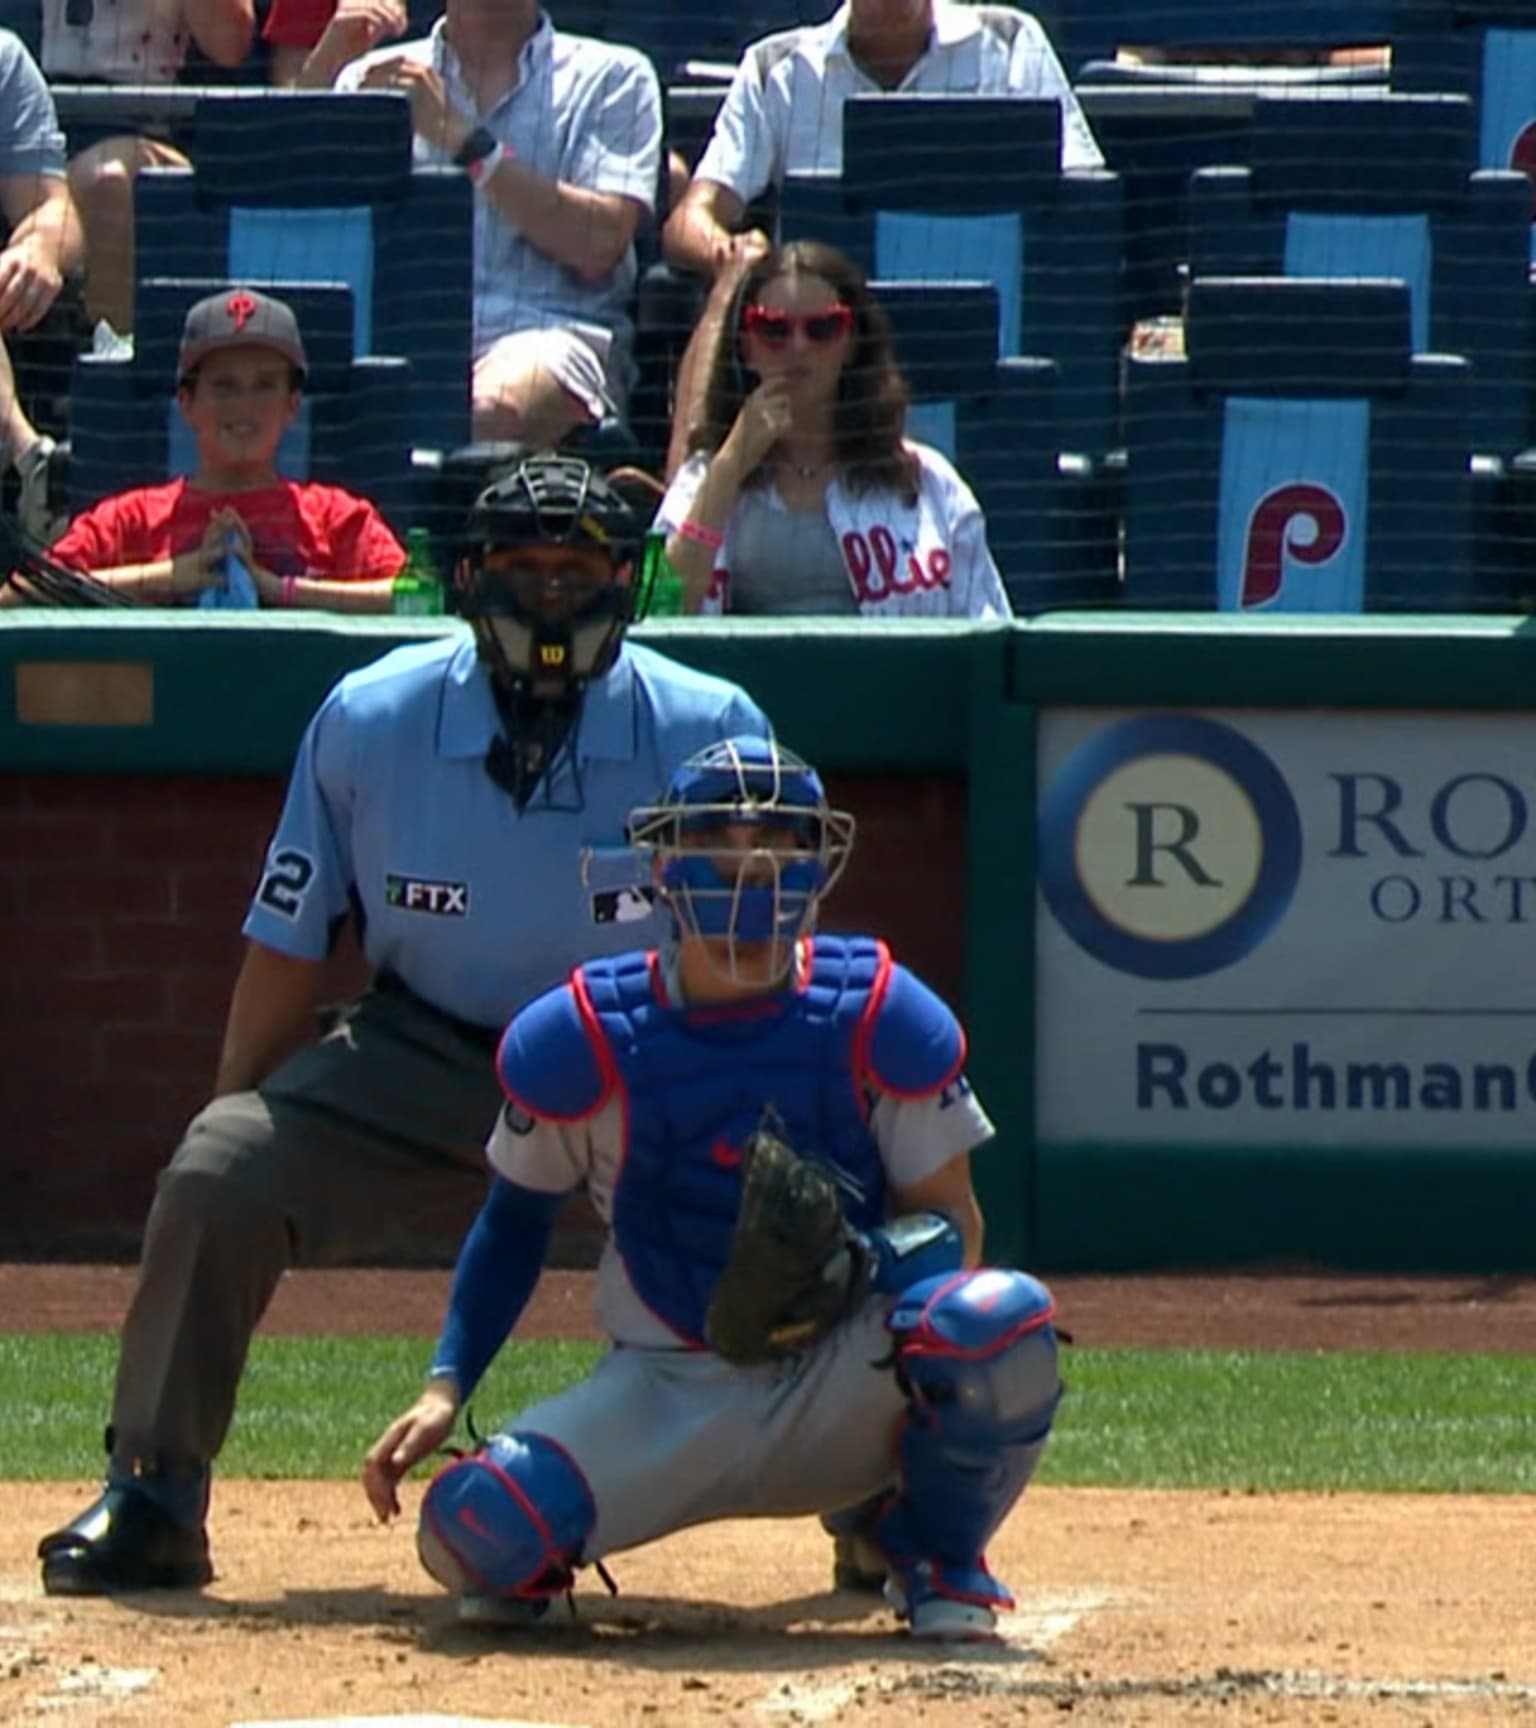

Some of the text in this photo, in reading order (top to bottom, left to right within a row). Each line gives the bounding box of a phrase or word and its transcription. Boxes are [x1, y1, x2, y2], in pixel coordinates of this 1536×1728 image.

[227, 294, 257, 332] P
[1239, 480, 1350, 610] P
[1123, 802, 1223, 888] R
[1326, 772, 1528, 860] RO
[257, 848, 318, 920] 2
[406, 882, 467, 914] FTX
[1370, 874, 1536, 924] ORT
